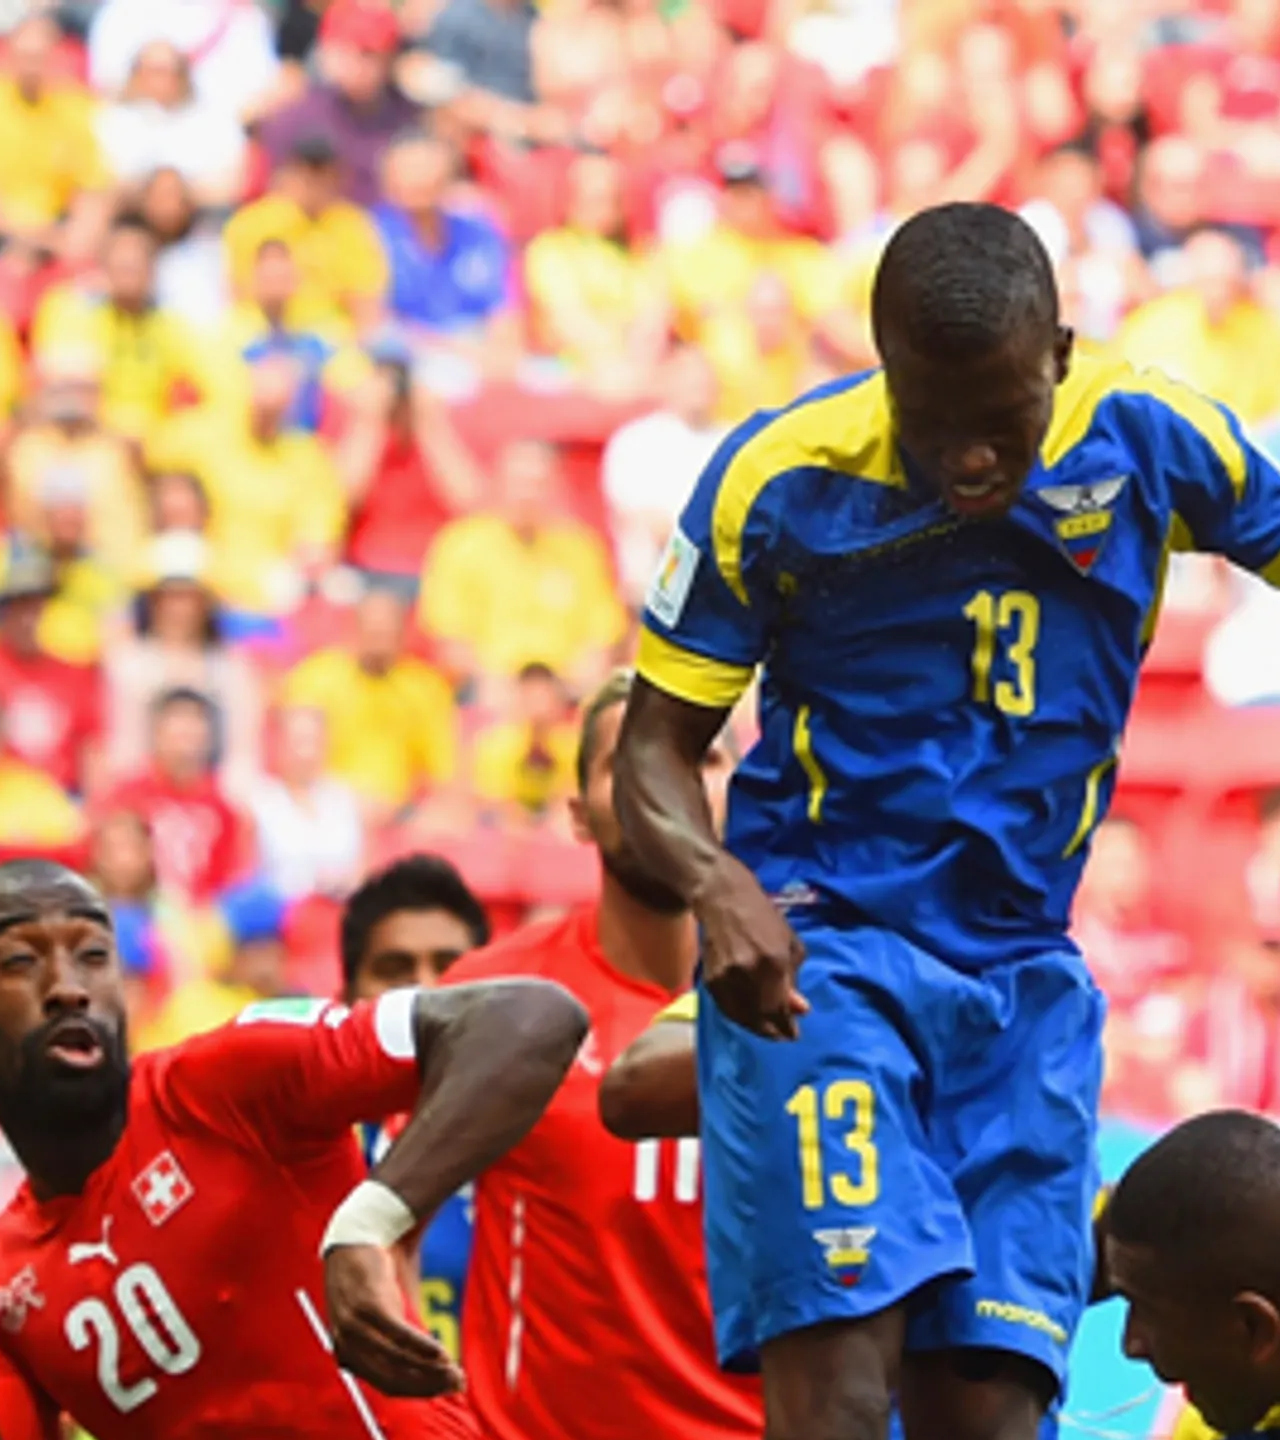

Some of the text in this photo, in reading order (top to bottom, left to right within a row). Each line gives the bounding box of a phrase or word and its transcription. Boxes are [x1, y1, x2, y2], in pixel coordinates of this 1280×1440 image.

[962, 590, 1040, 717] 13
[786, 1079, 880, 1210] 13
[65, 1261, 201, 1414] 20
